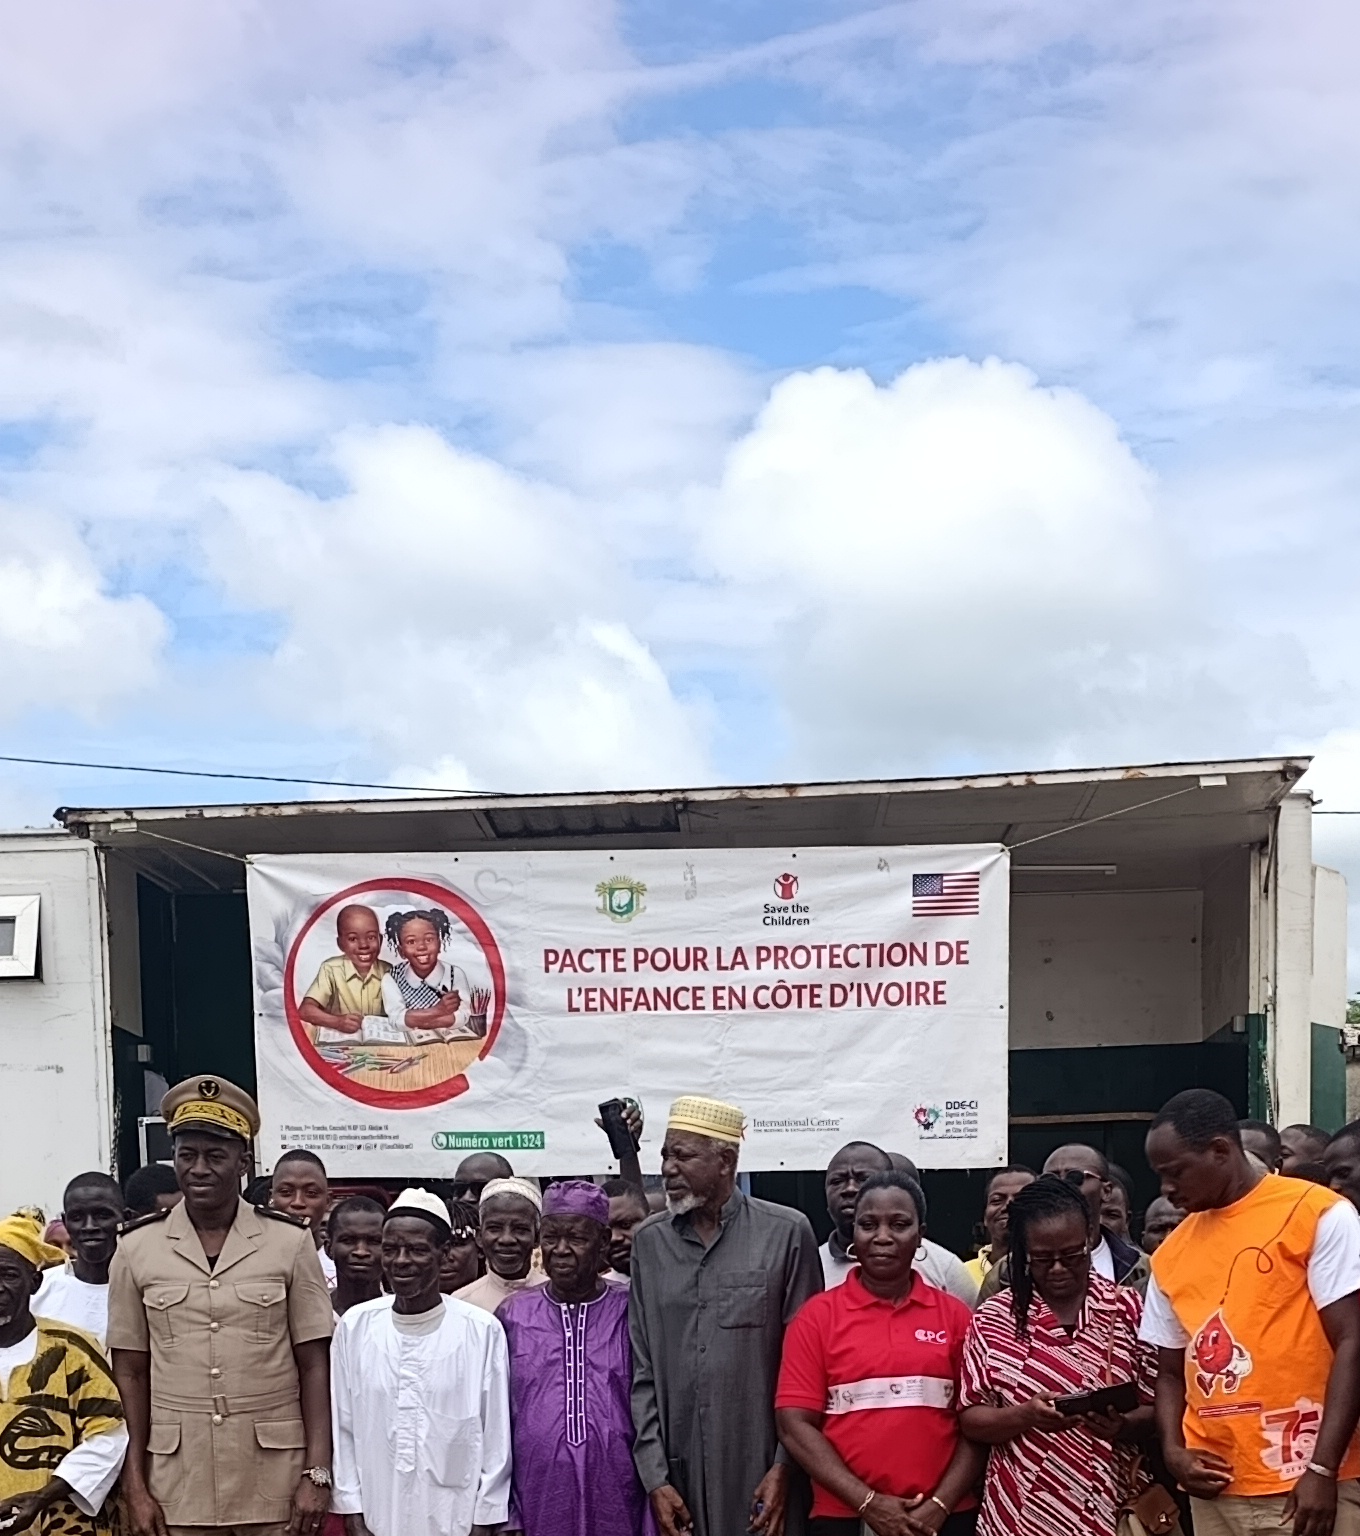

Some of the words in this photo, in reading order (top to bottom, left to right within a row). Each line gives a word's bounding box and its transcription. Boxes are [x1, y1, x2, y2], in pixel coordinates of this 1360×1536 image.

[763, 903, 789, 914] Save
[791, 903, 810, 914] the
[762, 915, 810, 926] Children
[543, 948, 627, 973] PACTE
[633, 947, 709, 972] POUR
[716, 946, 749, 972] LA
[756, 941, 928, 970] PROTECTION
[935, 940, 969, 966] DE
[567, 986, 705, 1013] L'ENFANCE
[712, 985, 746, 1011] EN
[752, 979, 822, 1010] CÔTE
[829, 980, 947, 1008] D'IVOIRE
[753, 1117, 809, 1128] International
[810, 1116, 840, 1127] Centre
[448, 1134, 489, 1148] Numéro
[491, 1134, 513, 1148] vert
[516, 1134, 542, 1148] 1324
